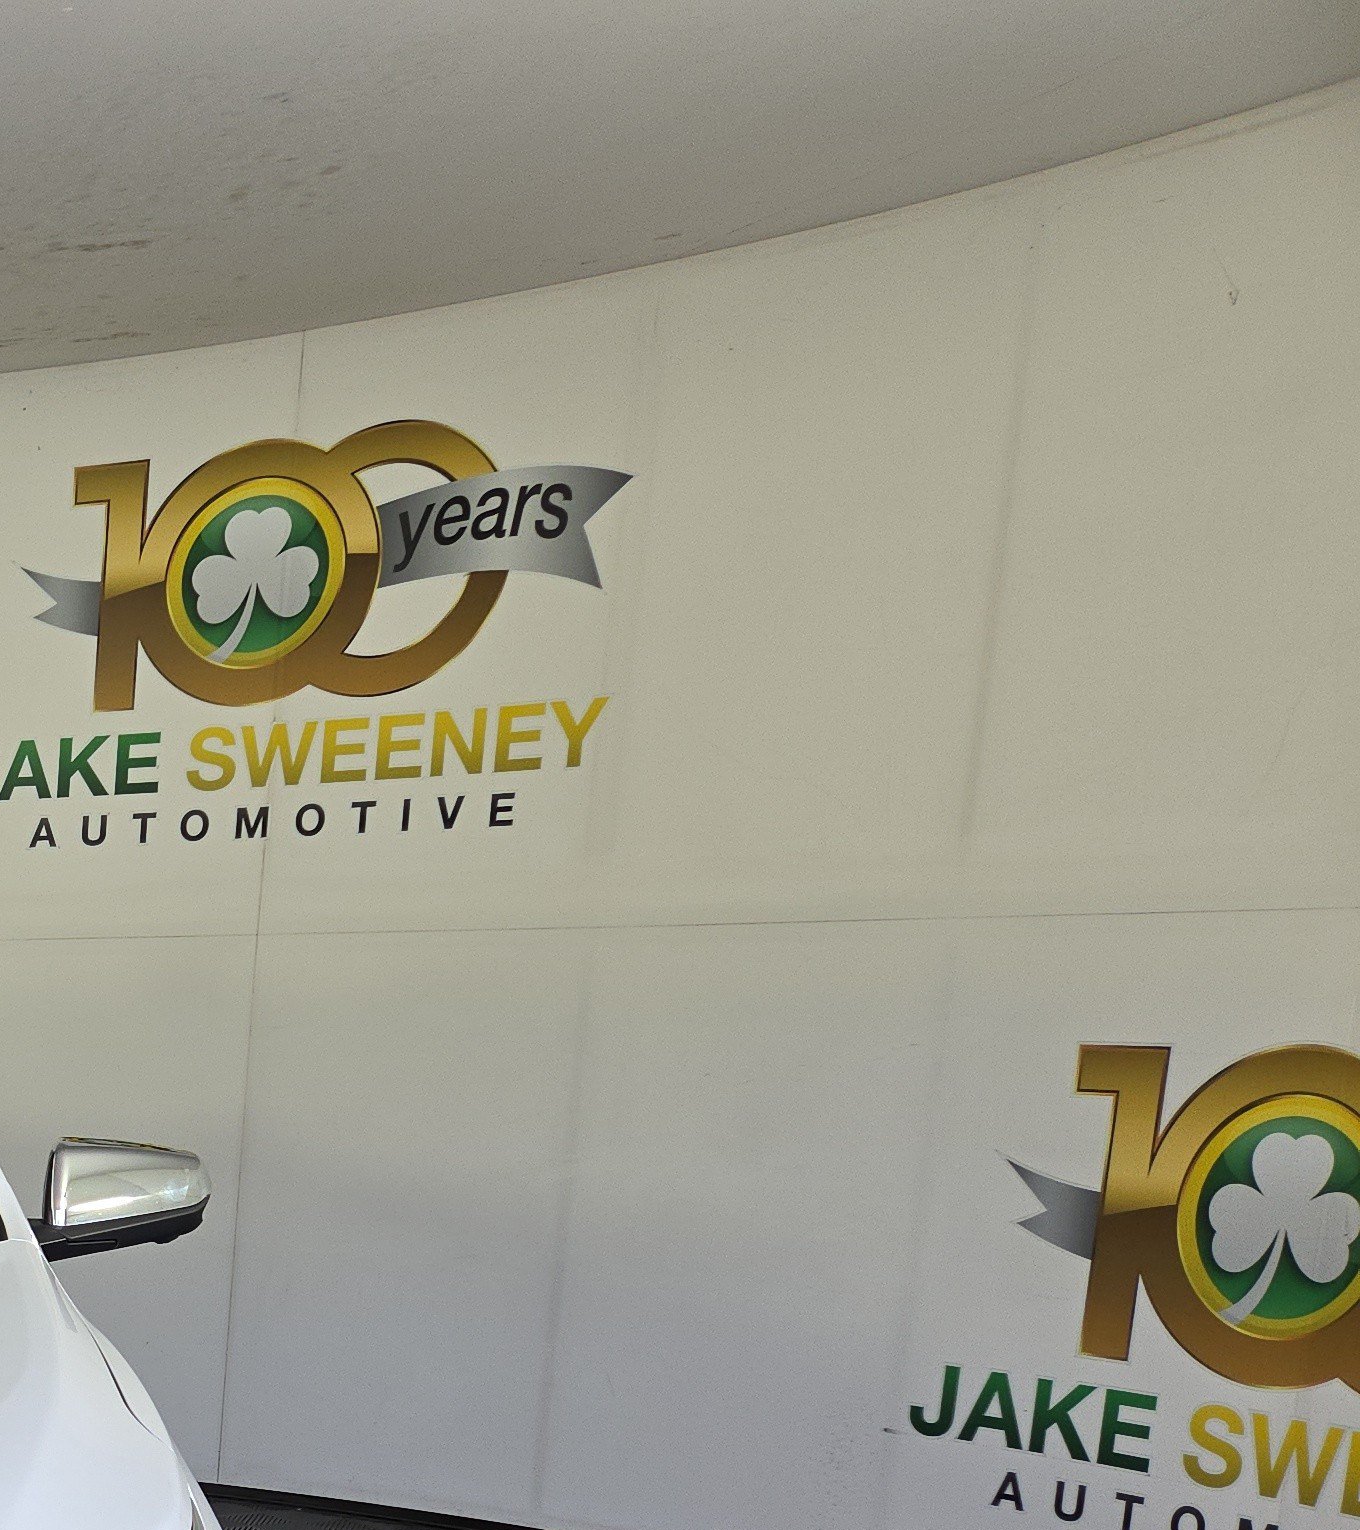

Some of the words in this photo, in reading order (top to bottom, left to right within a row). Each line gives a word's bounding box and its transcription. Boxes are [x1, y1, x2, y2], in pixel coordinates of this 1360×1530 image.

[73, 418, 511, 712] 100
[392, 481, 573, 574] years
[184, 696, 611, 792] SWEENEY
[28, 792, 516, 849] AUTOMOTIVE
[909, 1364, 1158, 1474] JAKE
